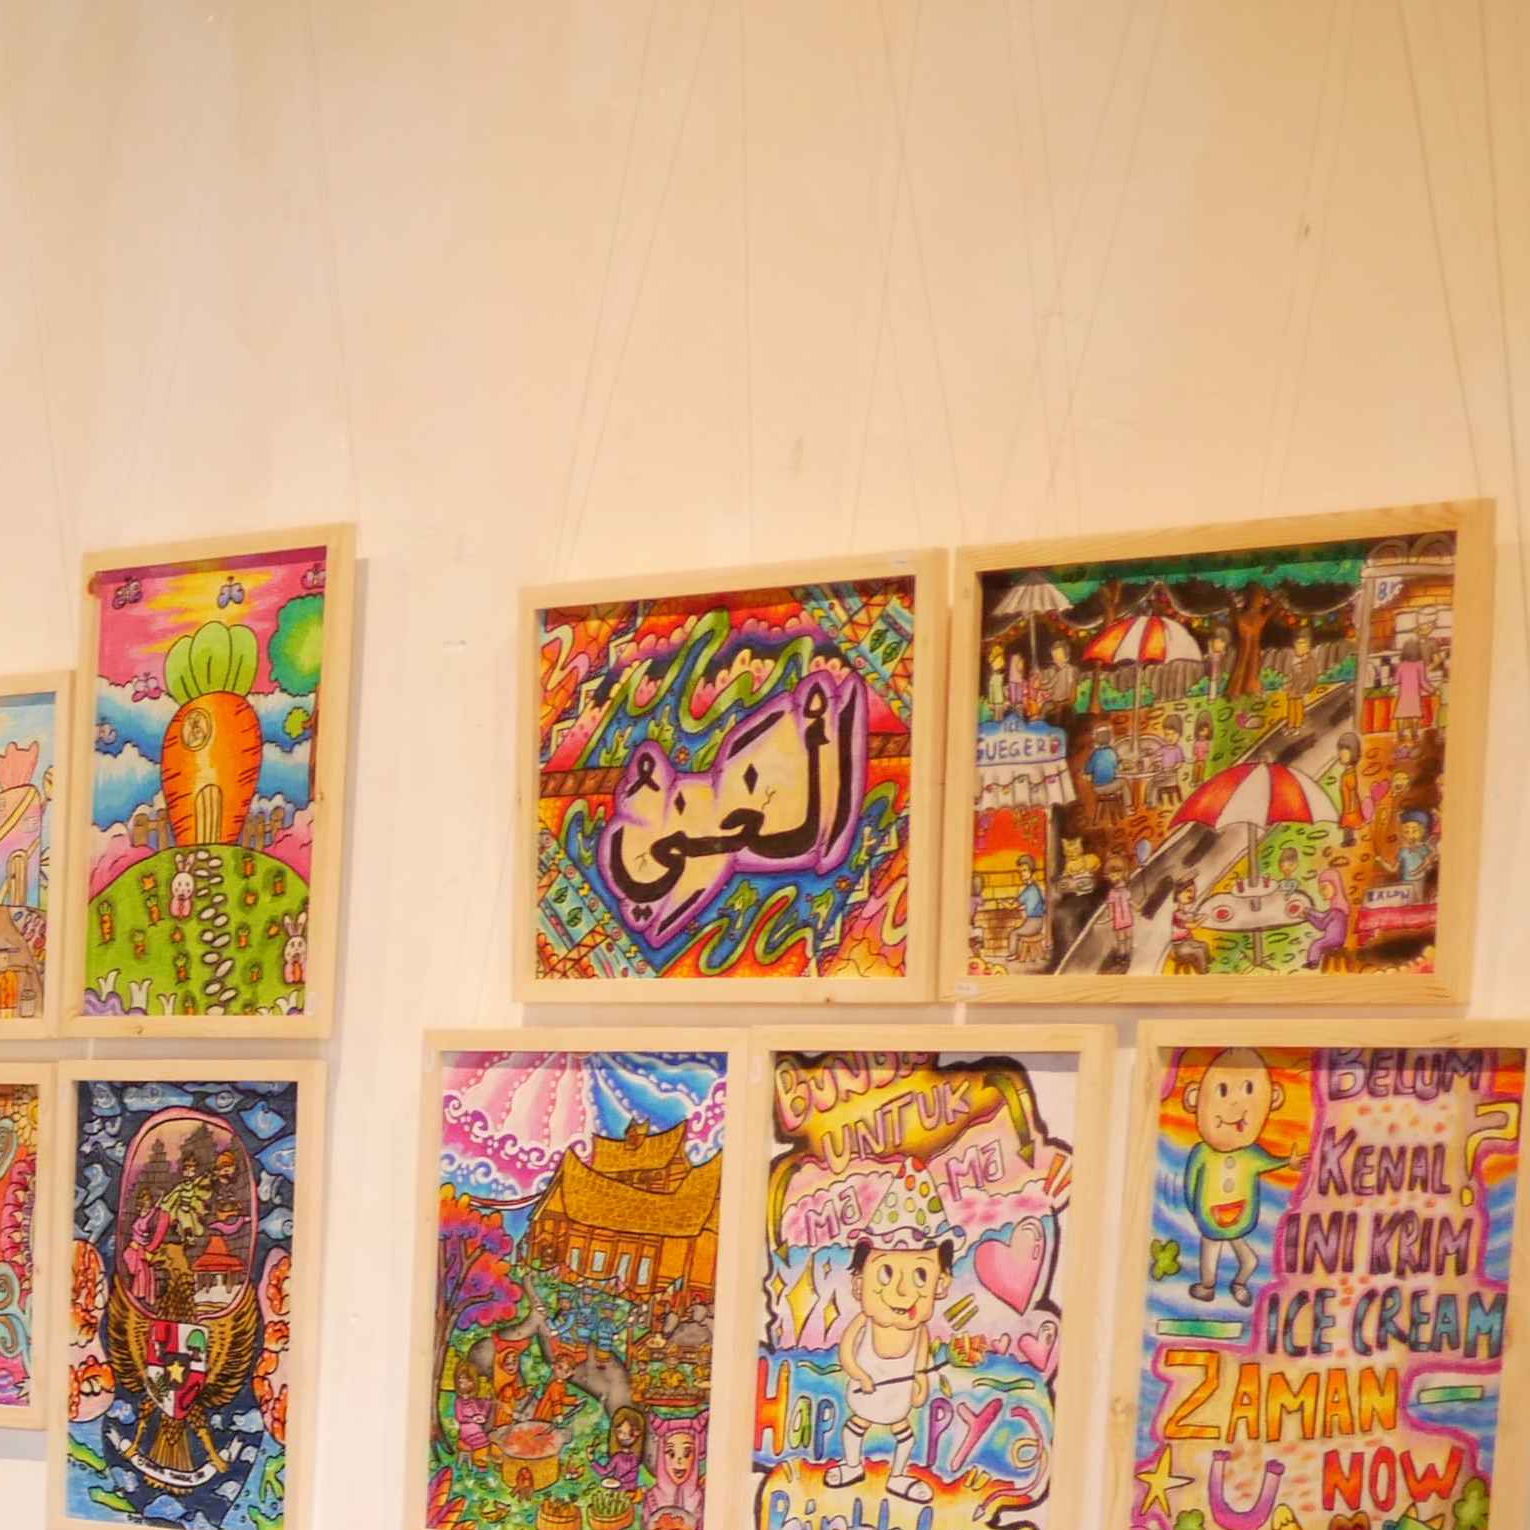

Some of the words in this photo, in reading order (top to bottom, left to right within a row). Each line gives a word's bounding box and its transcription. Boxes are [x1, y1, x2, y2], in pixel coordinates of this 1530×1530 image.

[1328, 1047, 1484, 1101] BELUM
[822, 1079, 972, 1174] UNTUK
[1318, 1126, 1451, 1196] KENAL
[1284, 1211, 1359, 1275] INI
[1369, 1209, 1475, 1281] KRIM
[1266, 1287, 1336, 1357] ICE
[1352, 1286, 1508, 1360] CREAM
[1163, 1348, 1400, 1444] ZAMAN
[1322, 1445, 1465, 1512] NOW
